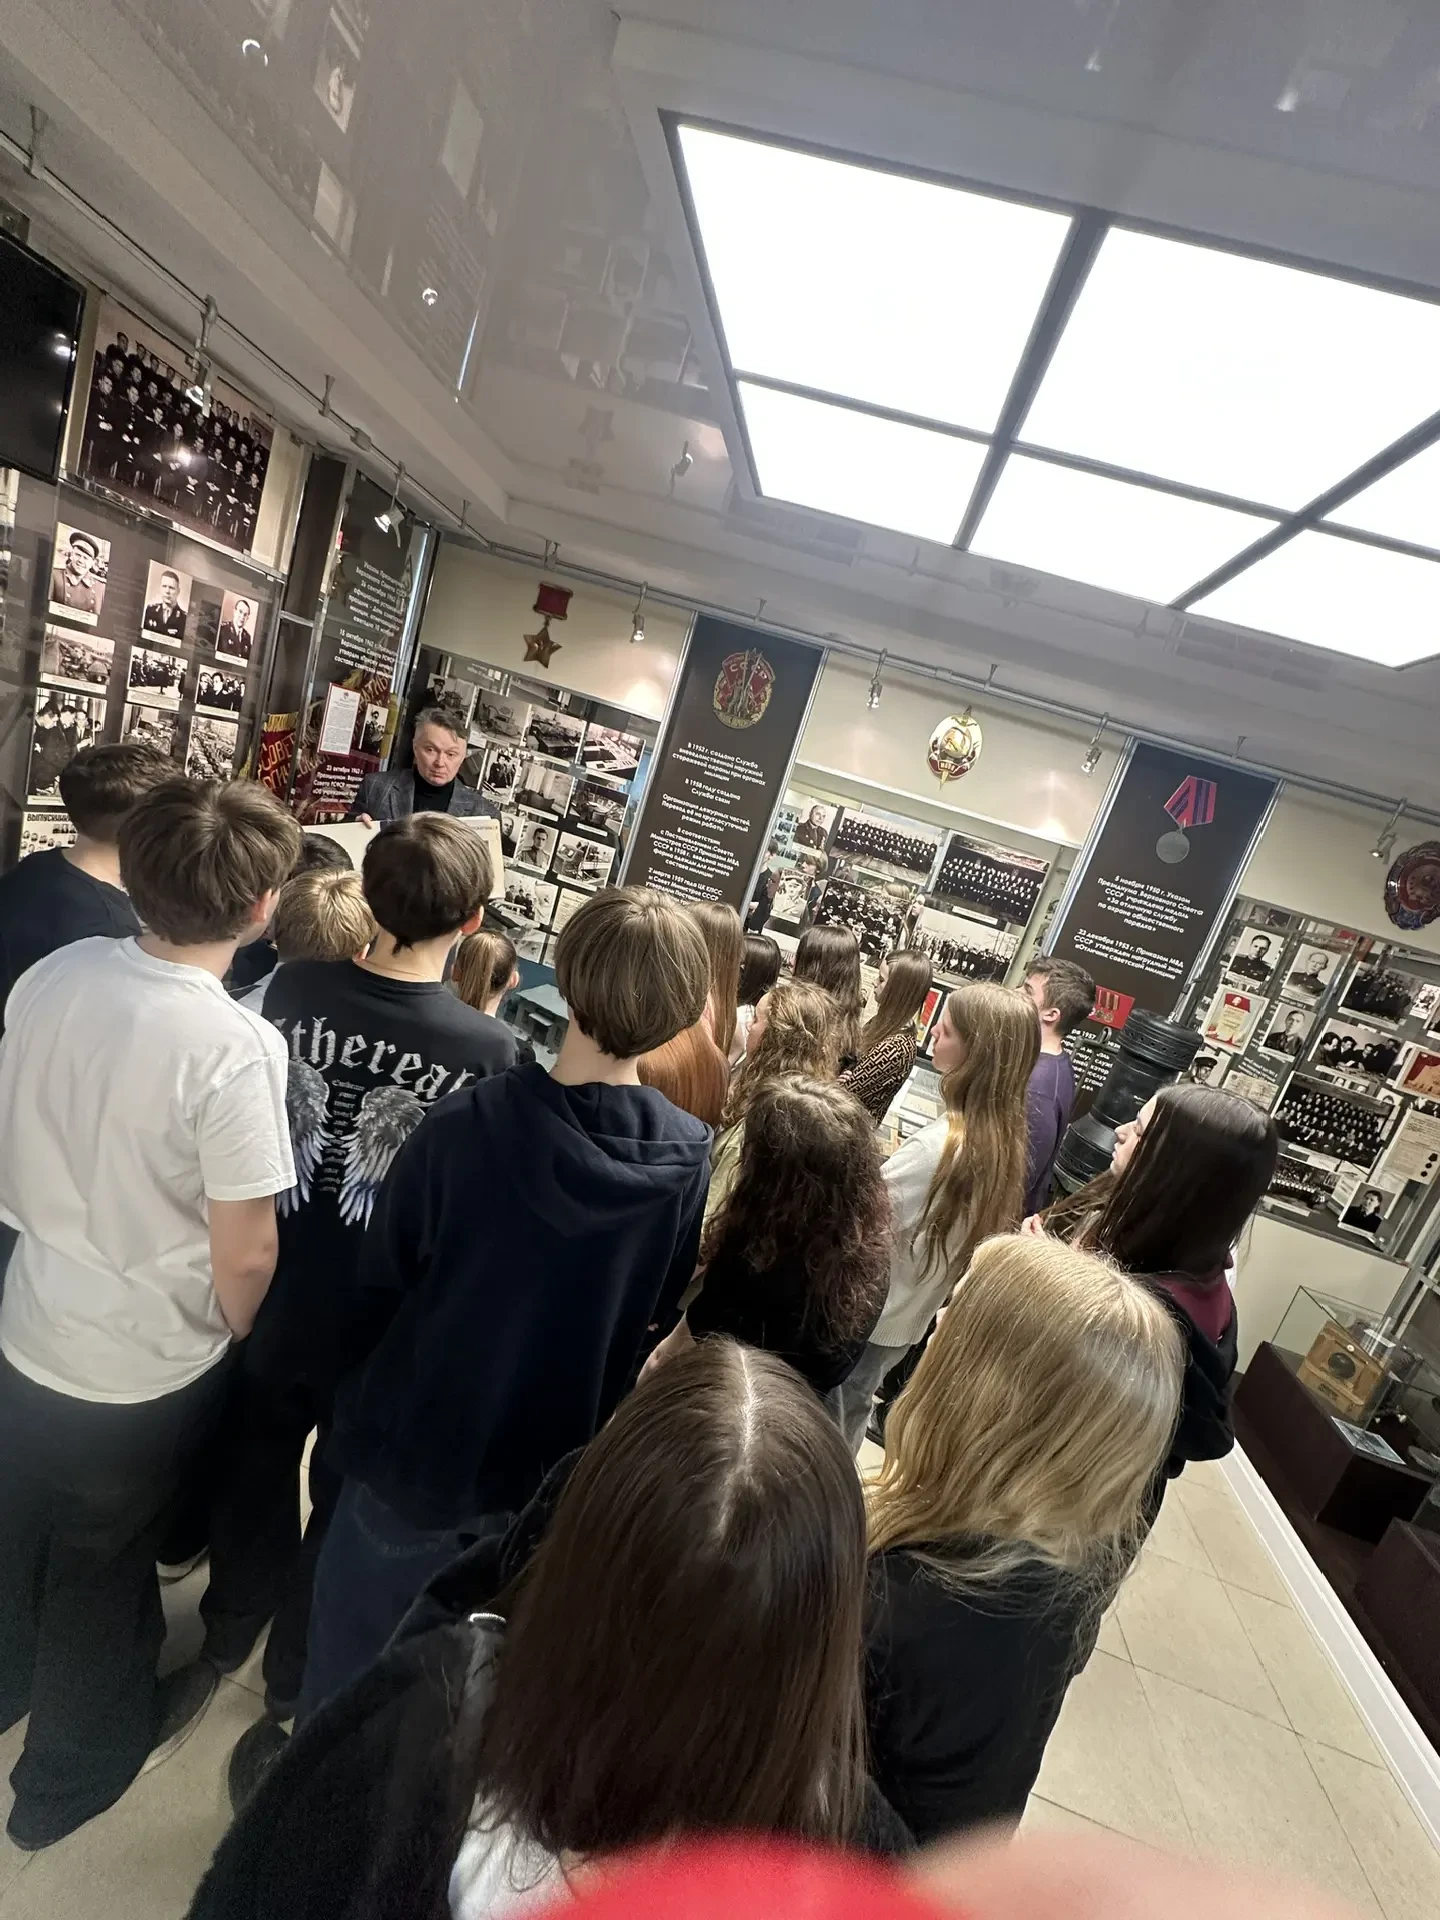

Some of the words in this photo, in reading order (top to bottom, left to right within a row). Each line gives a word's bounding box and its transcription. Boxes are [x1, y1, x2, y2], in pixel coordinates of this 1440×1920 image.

[692, 743, 705, 753] 1952
[709, 749, 736, 762] создана
[735, 756, 759, 770] Служба
[691, 787, 715, 801] Служба
[1104, 887, 1124, 898] СССР
[1119, 877, 1145, 890] ноября
[1145, 883, 1160, 895] 1950
[1166, 891, 1191, 905] Указом
[1177, 902, 1204, 916] Совета
[1106, 904, 1132, 917] охране
[1131, 912, 1185, 934] общественного
[1152, 911, 1179, 924] службу
[1073, 934, 1094, 946] СССР
